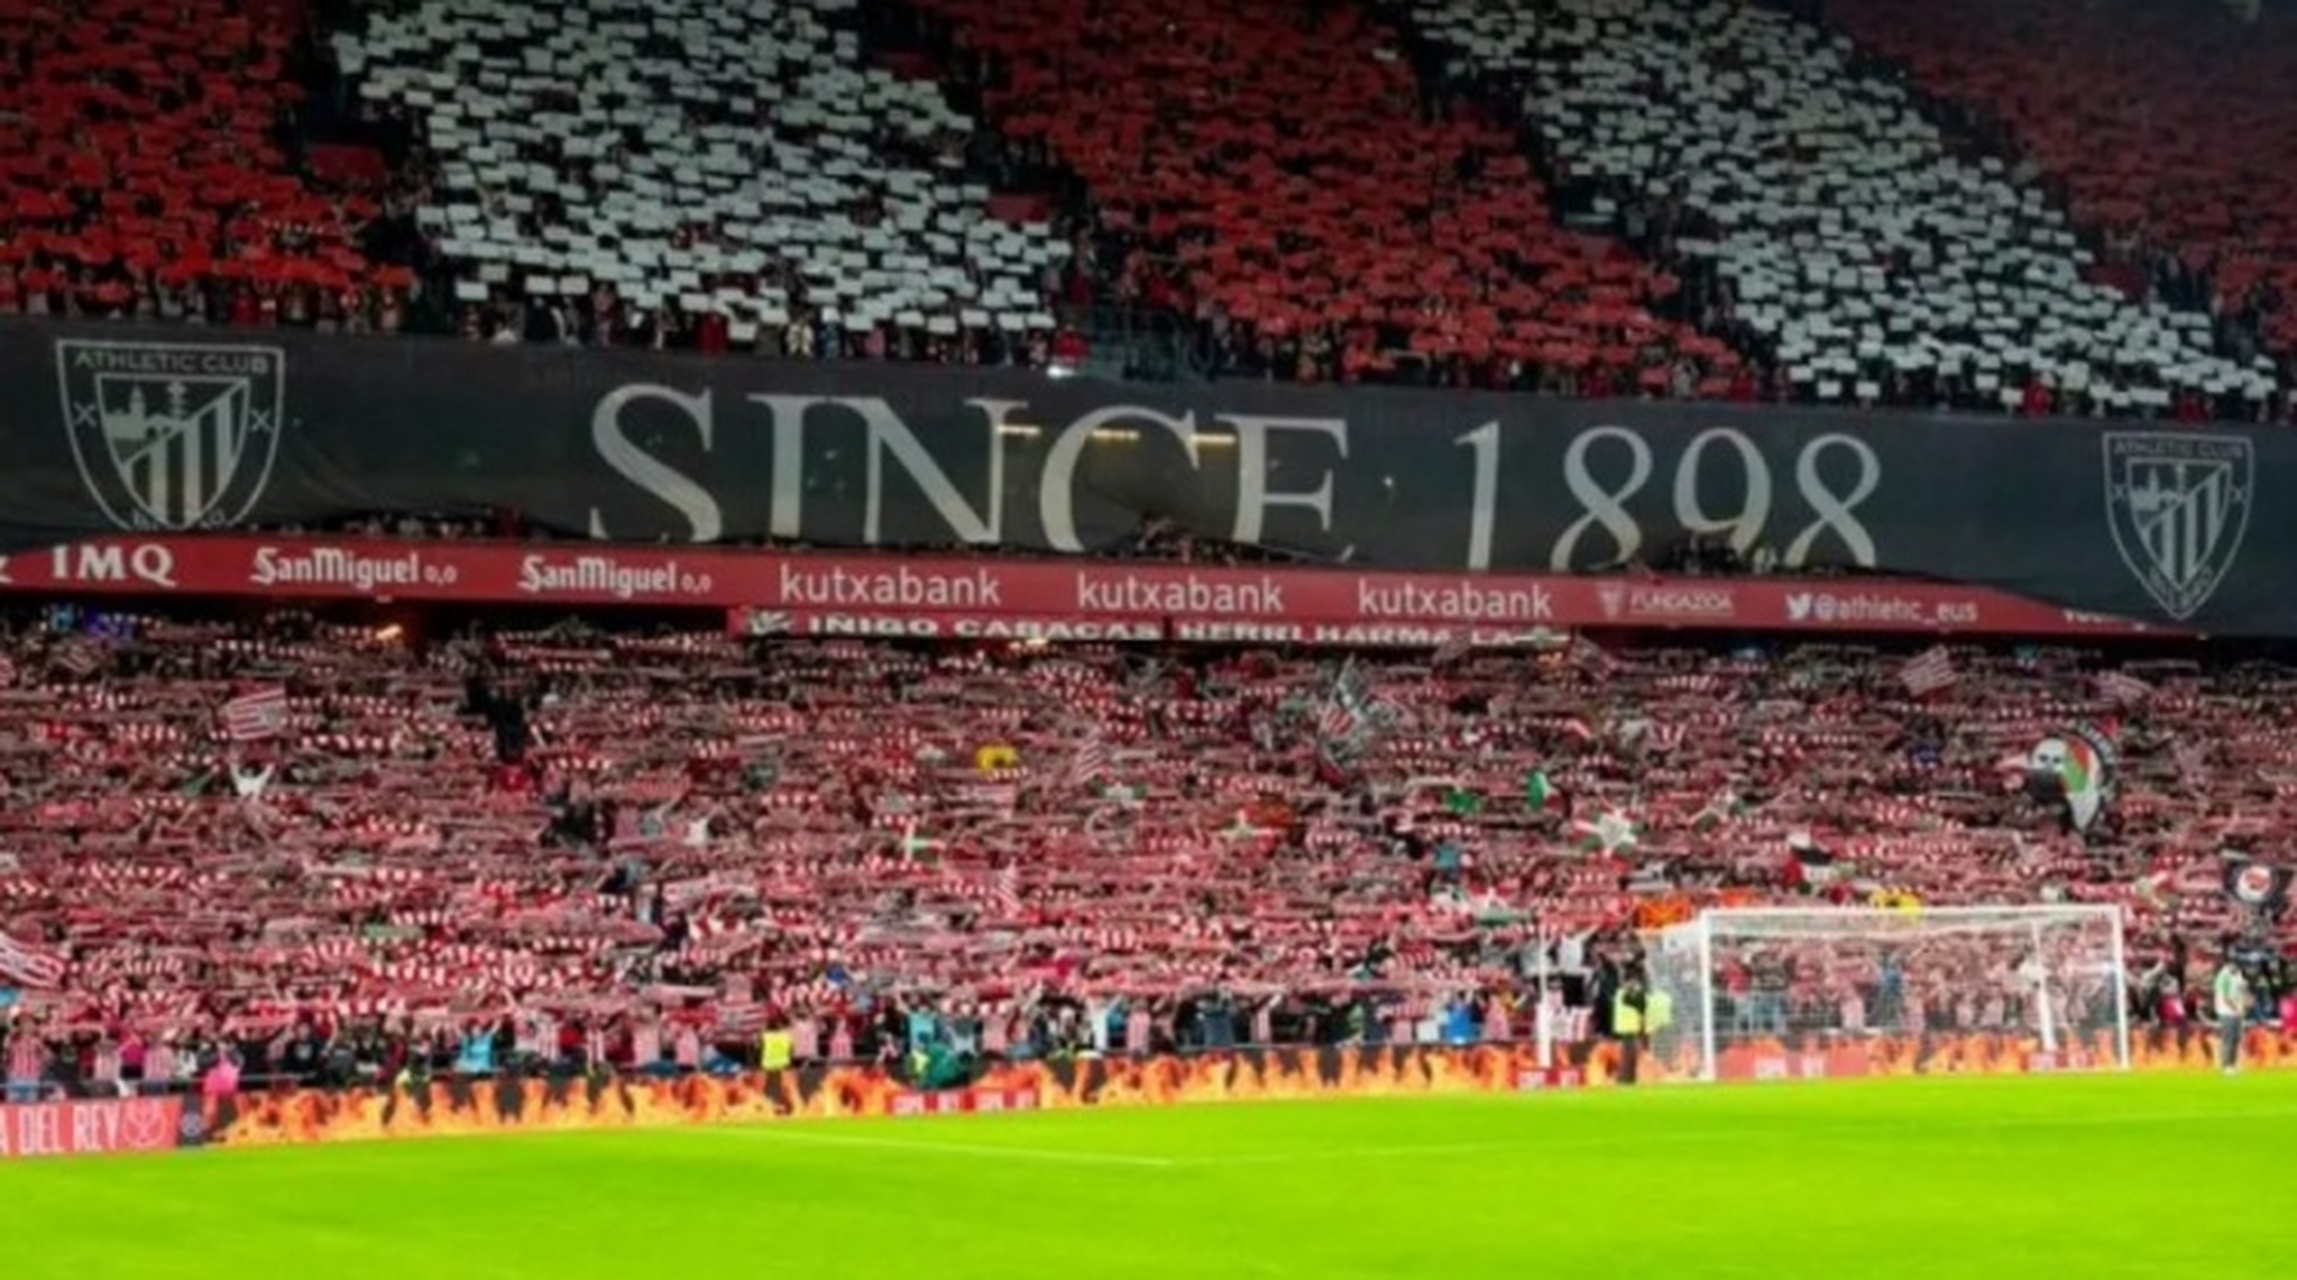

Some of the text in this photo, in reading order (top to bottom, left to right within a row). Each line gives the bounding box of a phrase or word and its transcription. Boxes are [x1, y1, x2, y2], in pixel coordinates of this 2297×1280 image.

[73, 350, 269, 375] ATHLETIC CLUB
[591, 383, 1881, 572] SINCE 1898
[53, 543, 177, 587] IMQ
[779, 564, 1001, 605] kutxabank
[1077, 571, 1284, 613] kutxabank
[1359, 579, 1552, 619] kutxabank
[1815, 594, 1978, 625] @athletic_eus
[1180, 621, 1302, 641] HERRI
[19, 1104, 60, 1155] DEL
[73, 1101, 121, 1152] REY
